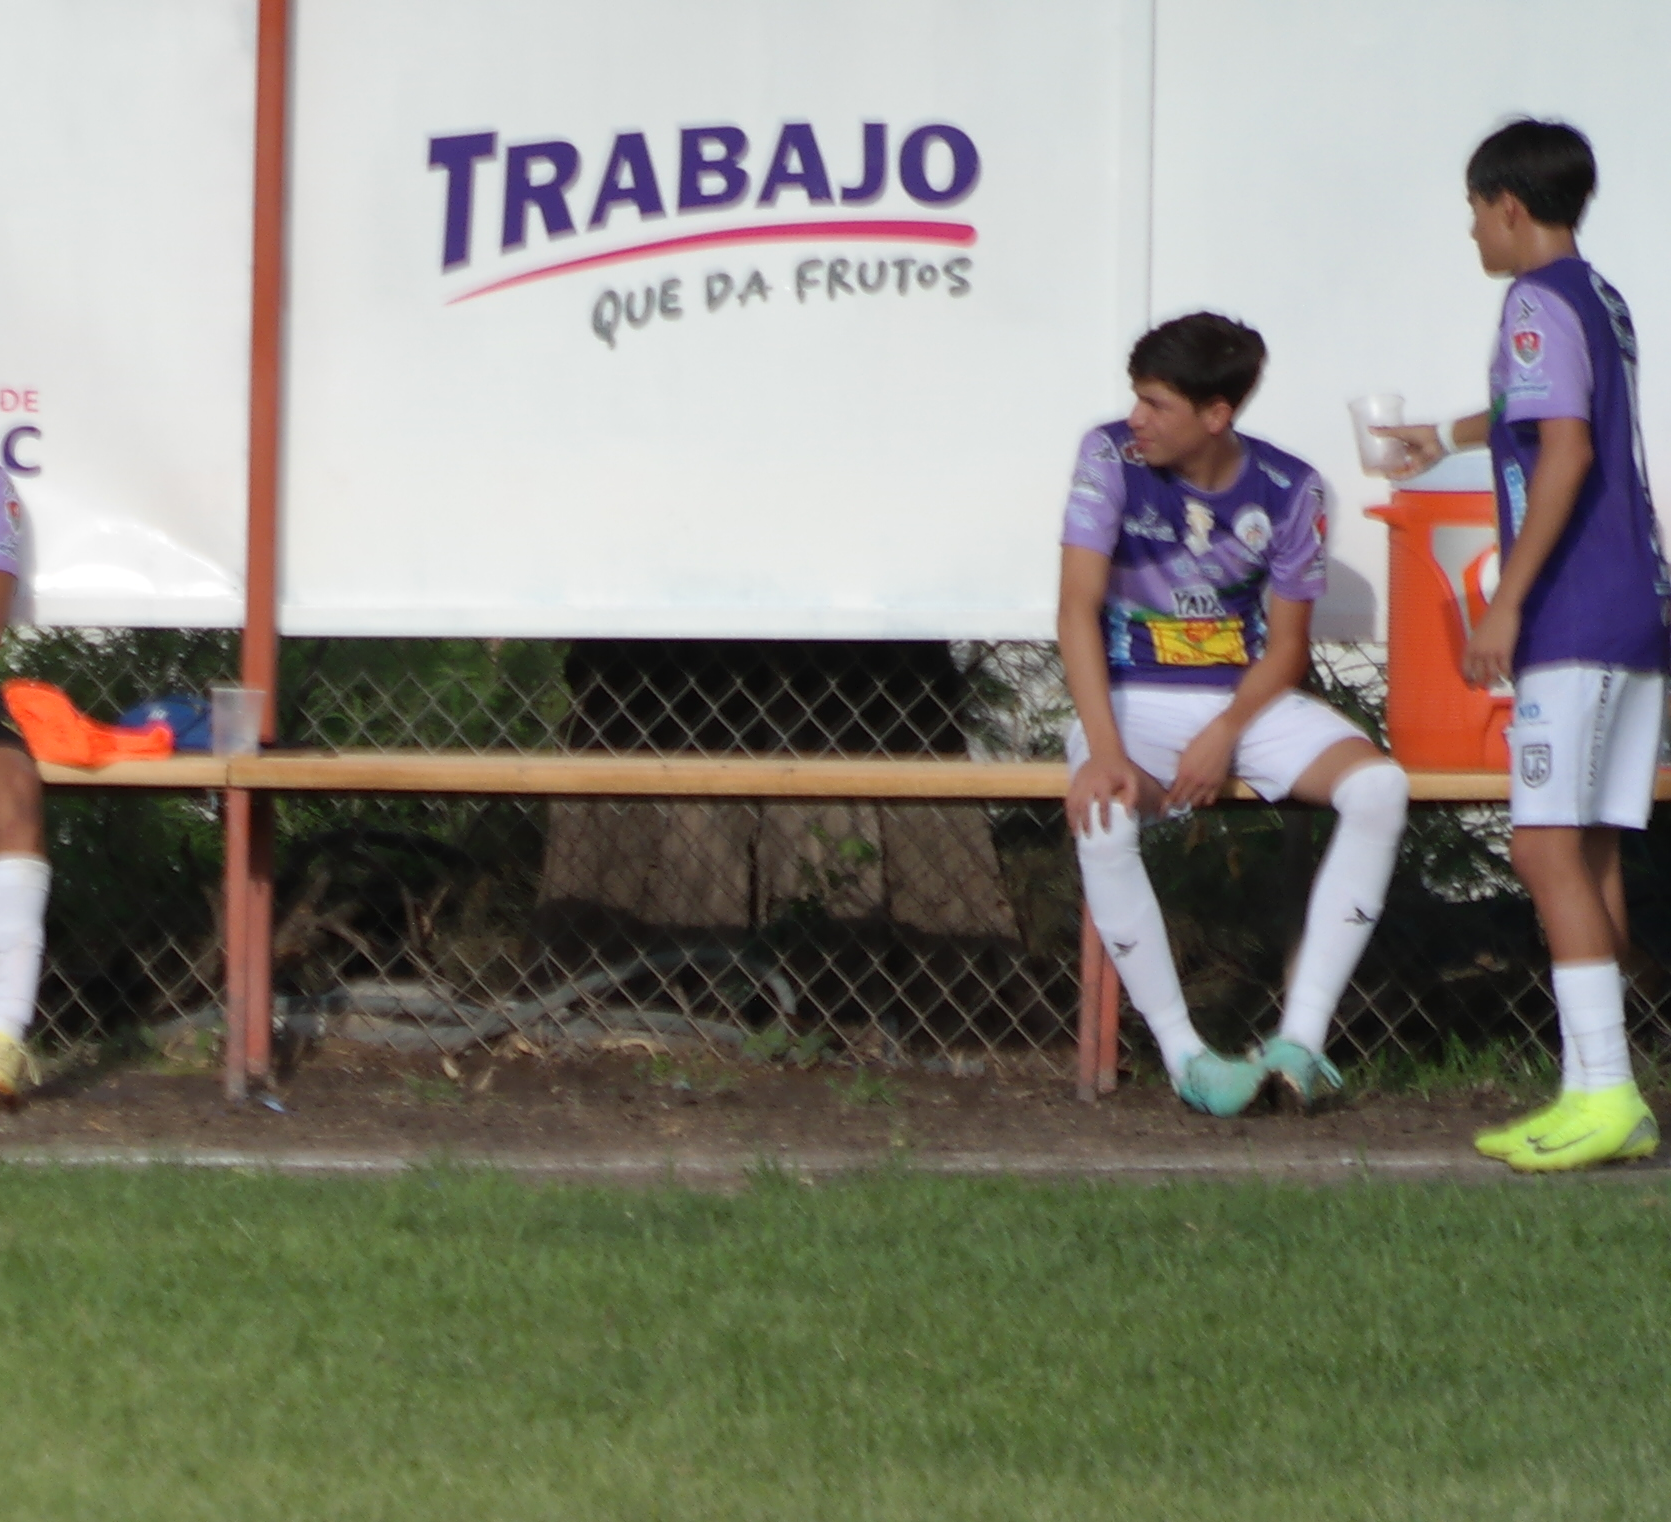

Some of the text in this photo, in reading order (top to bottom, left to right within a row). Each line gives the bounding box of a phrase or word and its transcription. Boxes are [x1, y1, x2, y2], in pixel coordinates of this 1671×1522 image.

[427, 121, 981, 275] TRABAJO
[591, 256, 974, 350] QUE DA FRUTOS
[0, 388, 40, 413] DE
